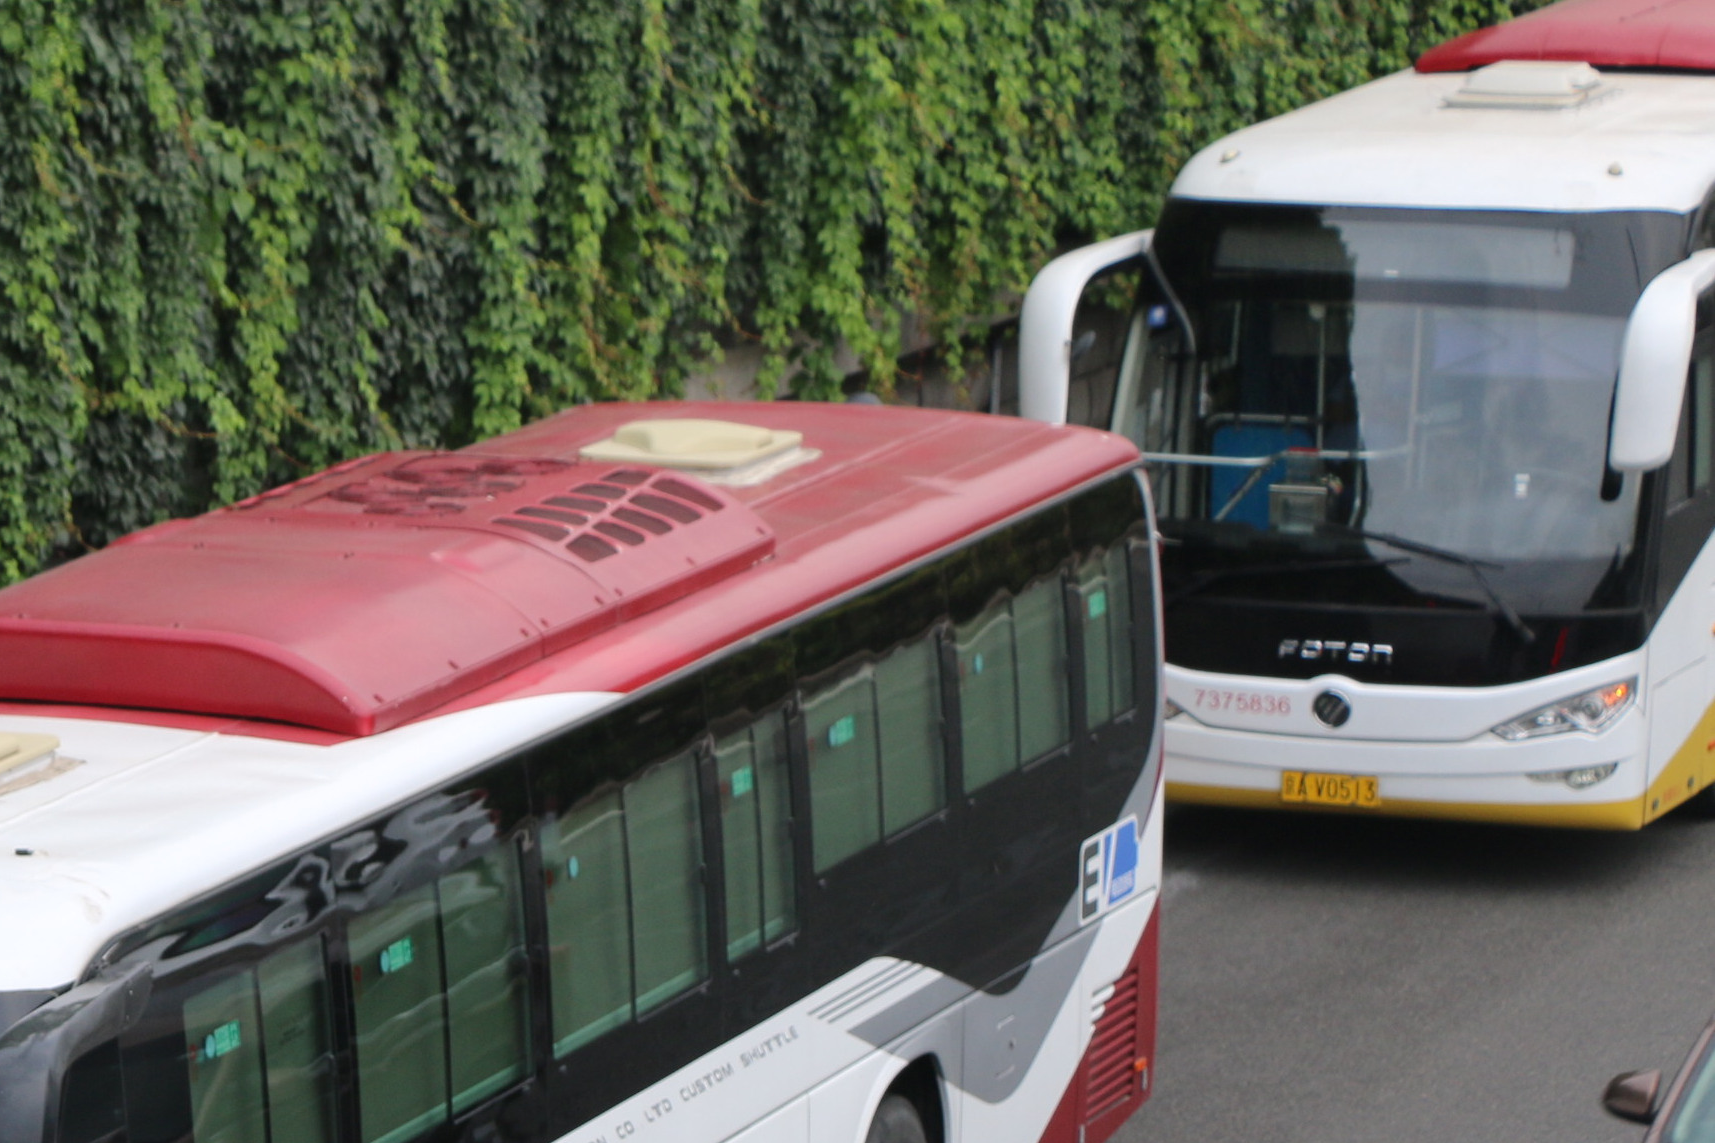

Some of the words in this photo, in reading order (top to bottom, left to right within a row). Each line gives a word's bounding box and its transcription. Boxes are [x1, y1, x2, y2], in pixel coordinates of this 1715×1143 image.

[1278, 639, 1394, 665] FOTON
[1195, 688, 1292, 716] 7375836
[615, 1120, 635, 1140] CO
[644, 1097, 674, 1123] LTD
[679, 1062, 735, 1102] CUSTOM
[739, 1025, 800, 1069] SHUTTLE
